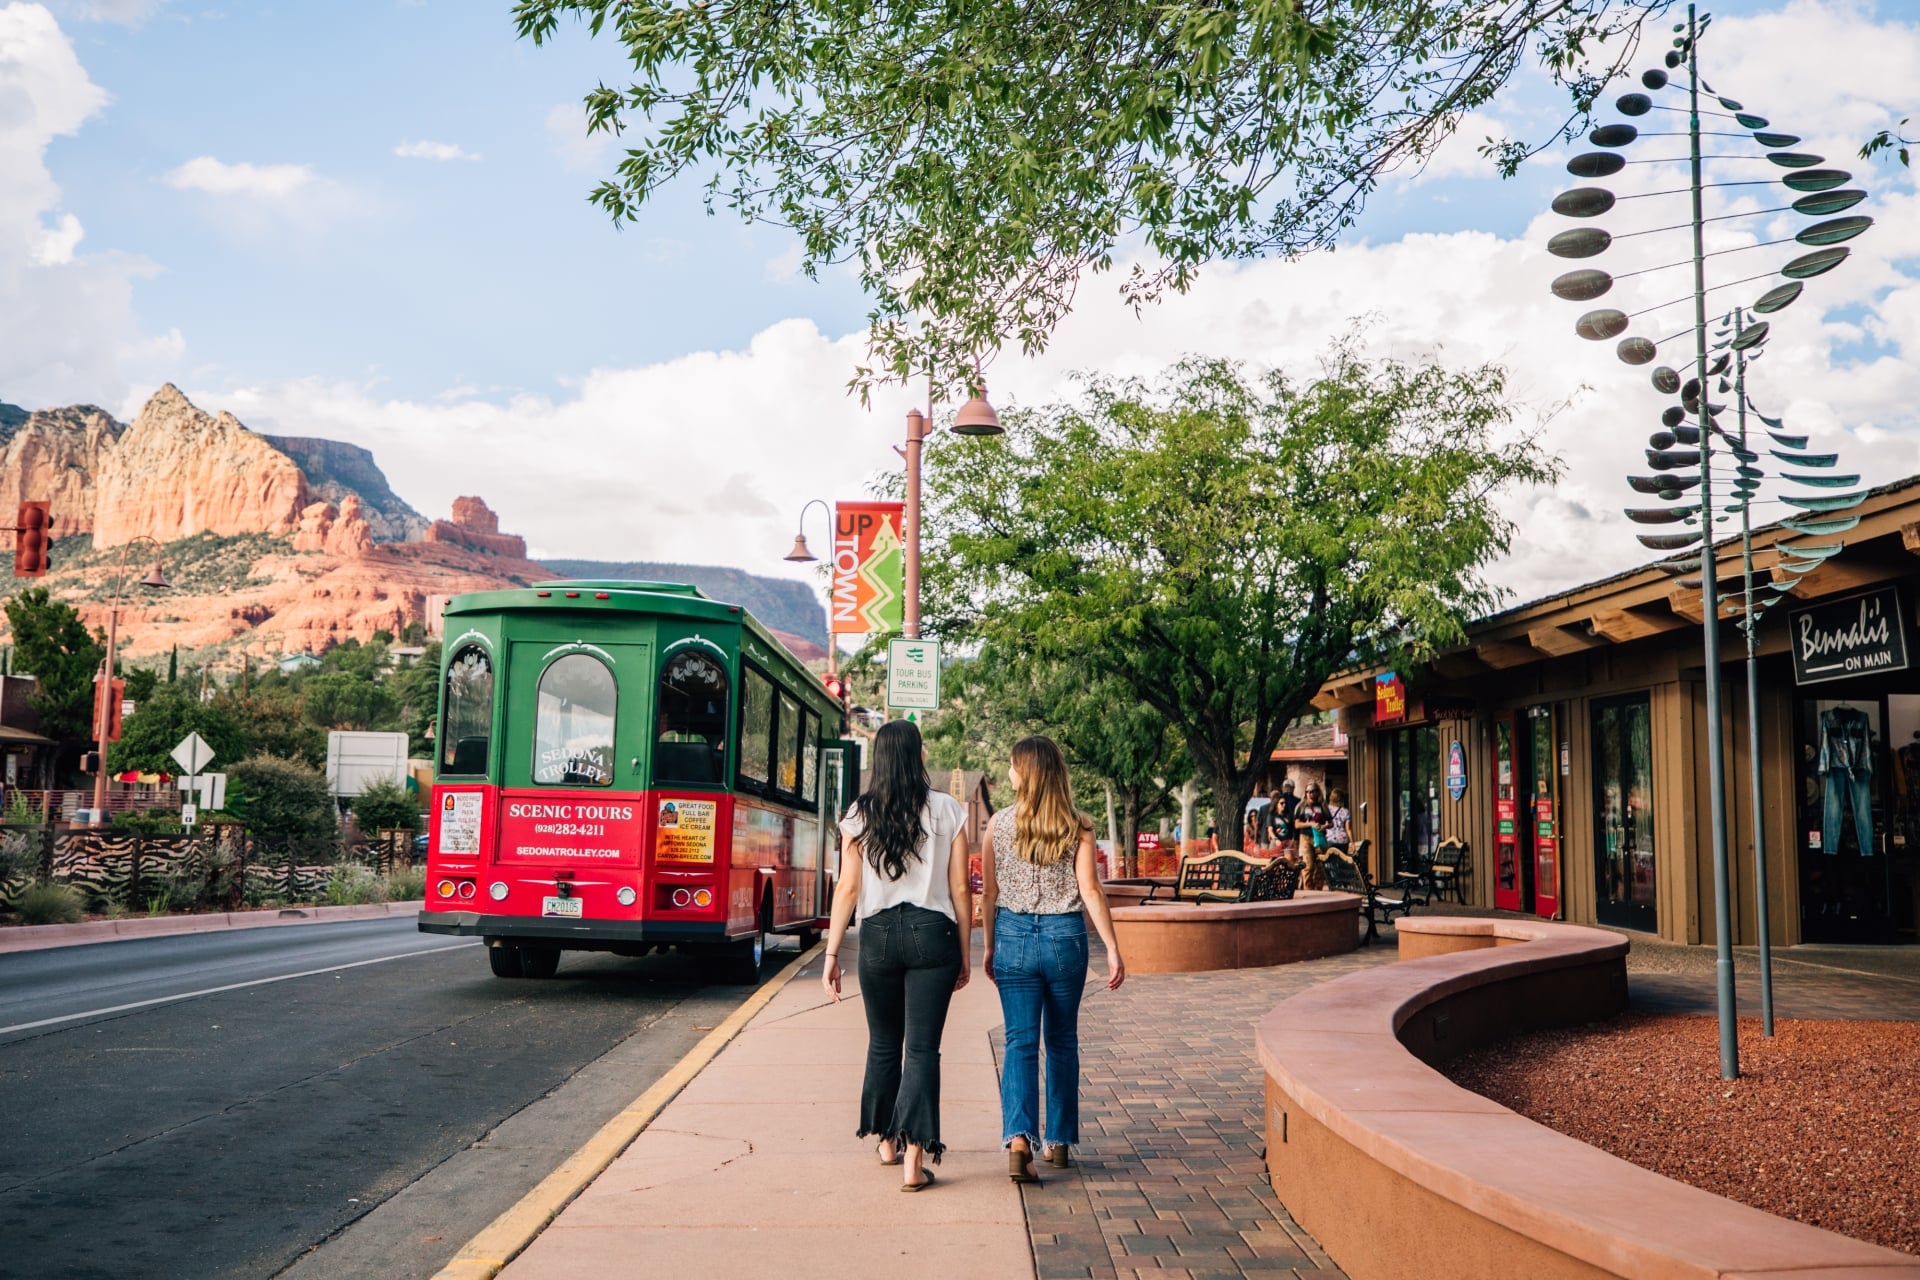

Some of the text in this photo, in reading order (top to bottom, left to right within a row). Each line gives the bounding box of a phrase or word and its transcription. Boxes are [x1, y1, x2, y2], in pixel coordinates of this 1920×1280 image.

[837, 514, 873, 536] UP
[834, 535, 859, 621] TOWN
[1799, 597, 1889, 662] Bennali's
[1845, 650, 1892, 671] ON MAIN
[896, 668, 932, 679] TOUR BUS
[898, 680, 928, 690] PARKING
[1376, 684, 1396, 700] Sedona
[1386, 696, 1404, 715] Trolley
[541, 747, 604, 767] SEDONA
[538, 761, 607, 781] TROLLEY
[509, 804, 633, 820] SCENIC TOURS
[535, 824, 604, 836] (928)282-4211
[1138, 833, 1159, 842] ATM
[516, 846, 620, 858] SEDONATROLLEY.COM
